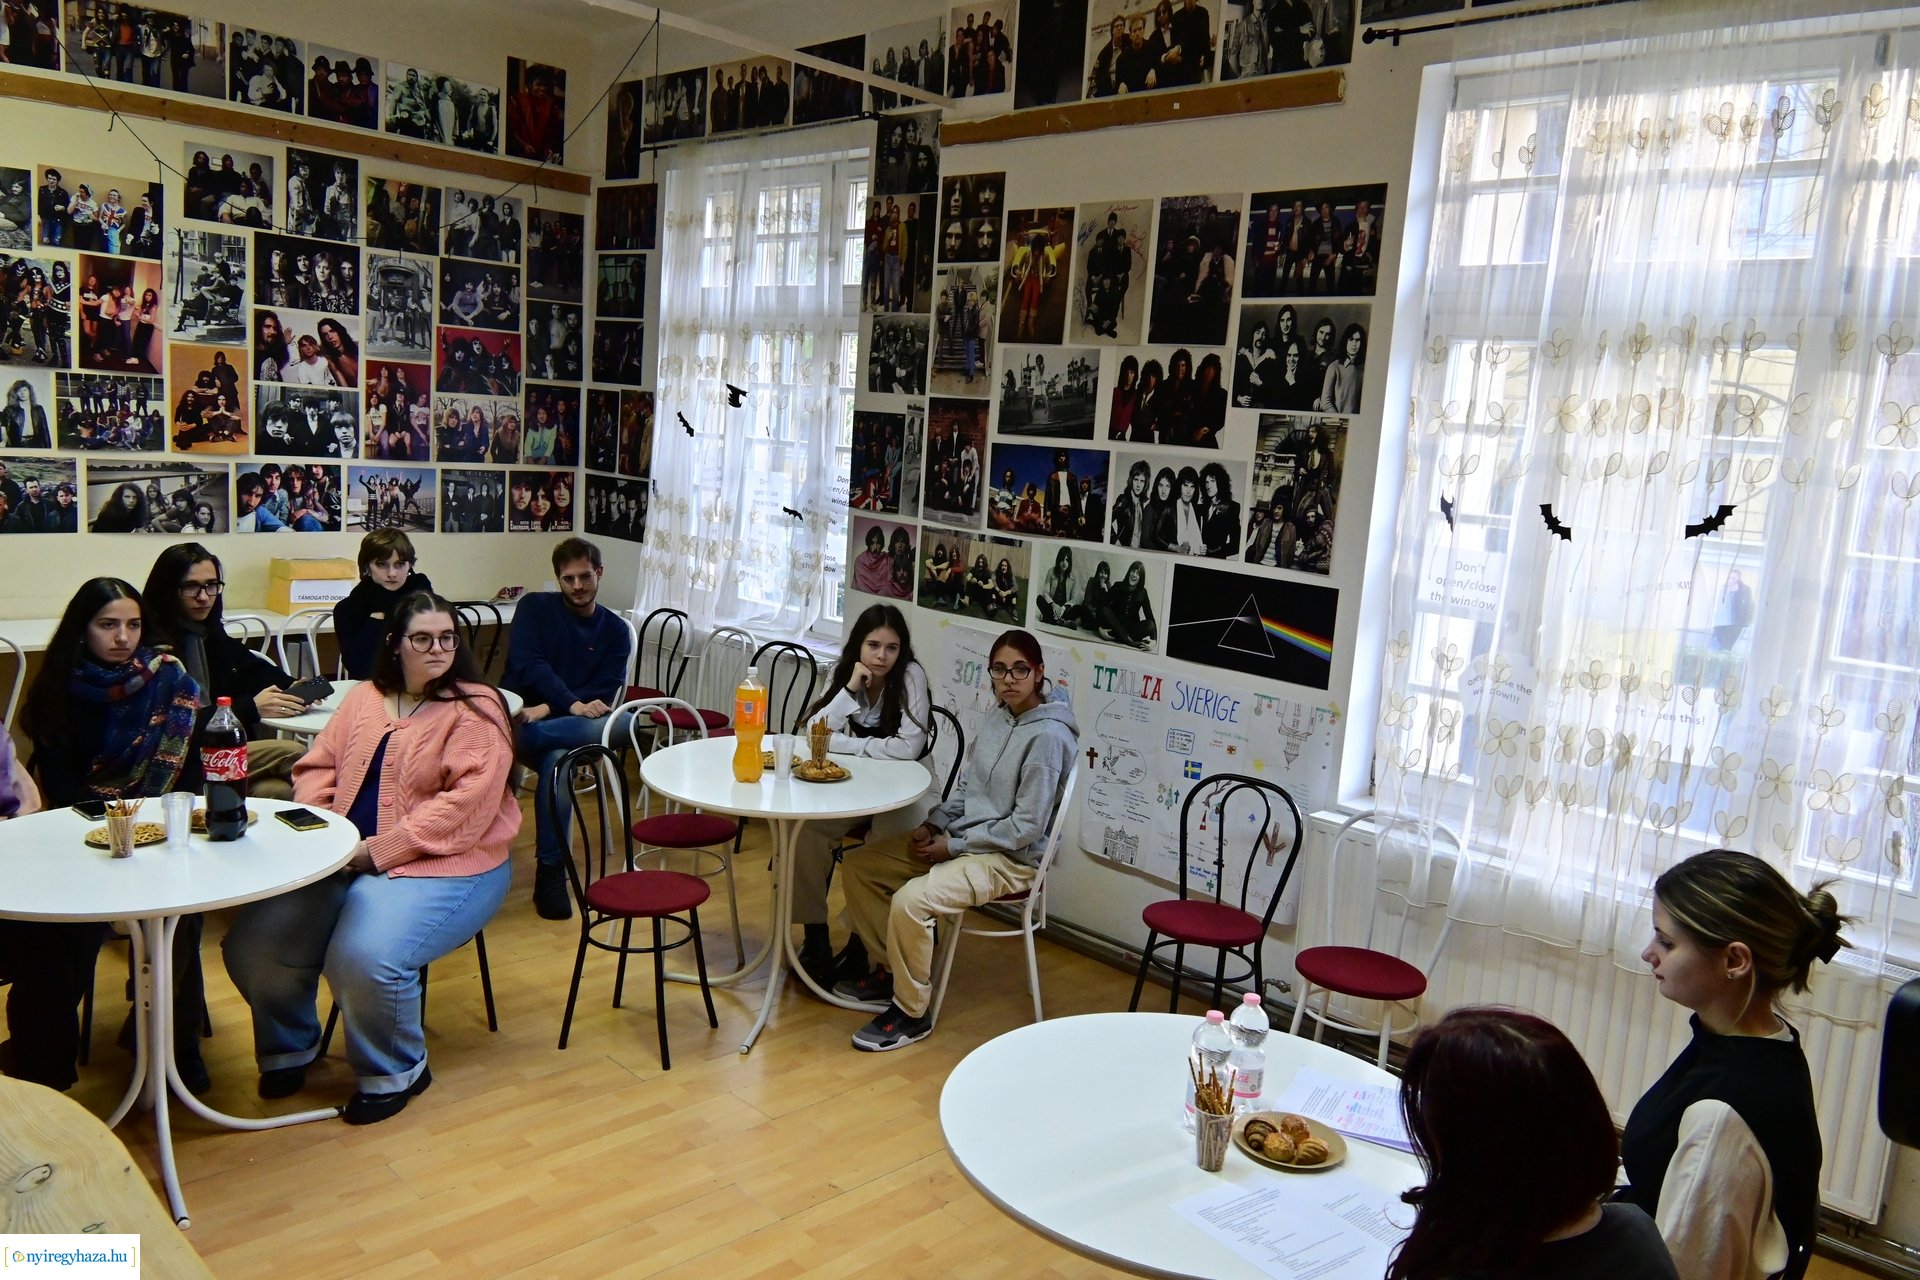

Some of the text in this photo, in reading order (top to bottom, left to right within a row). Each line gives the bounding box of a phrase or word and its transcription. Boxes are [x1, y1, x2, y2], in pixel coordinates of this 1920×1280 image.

[1455, 560, 1486, 575] Don't
[1450, 595, 1496, 611] window
[1093, 664, 1164, 702] ITALIA
[1516, 683, 1533, 696] the
[1171, 680, 1241, 723] SVERIGE
